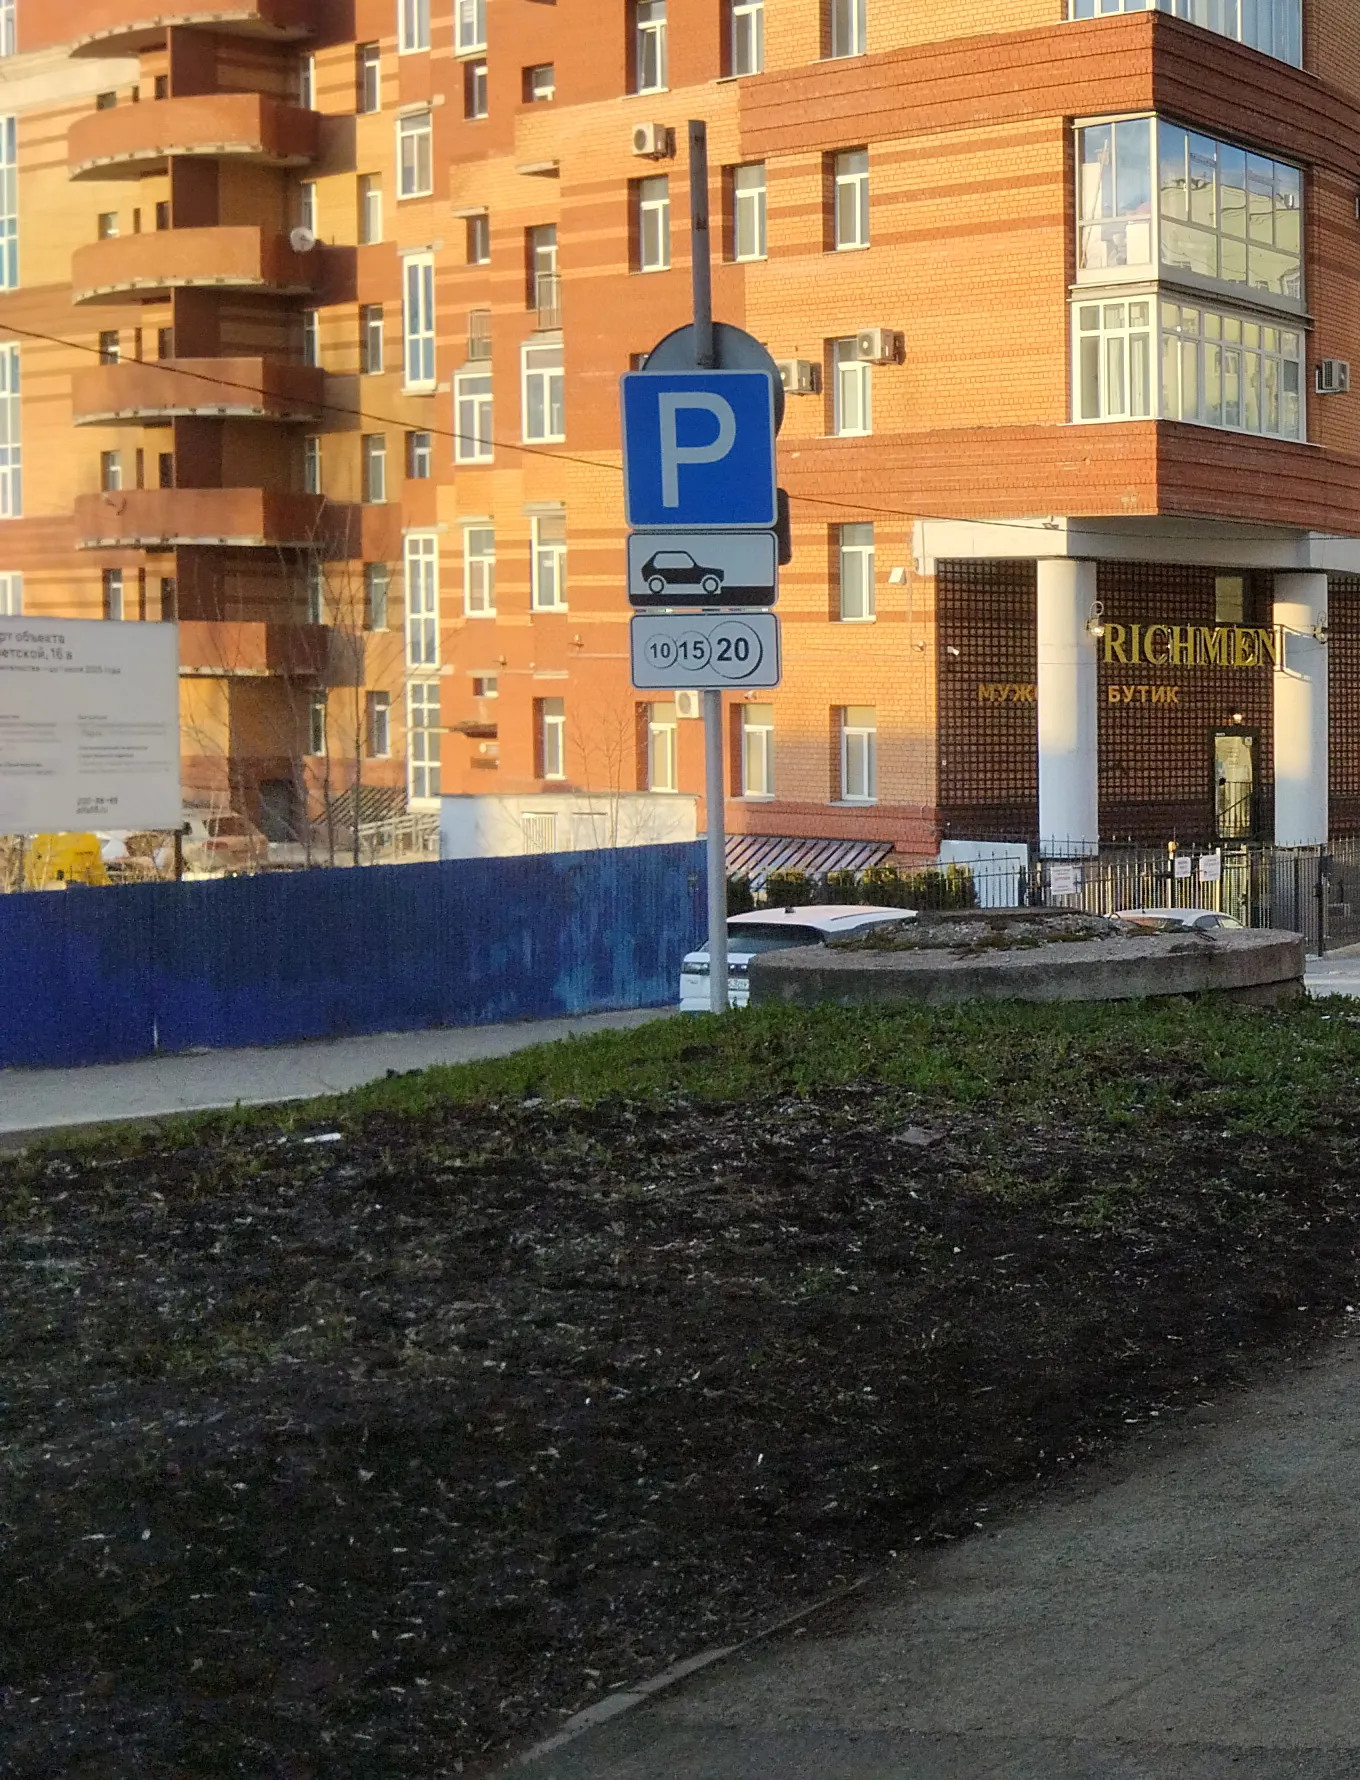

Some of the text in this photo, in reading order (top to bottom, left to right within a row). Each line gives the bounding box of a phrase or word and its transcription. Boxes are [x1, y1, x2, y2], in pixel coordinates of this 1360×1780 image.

[658, 391, 737, 508] P
[650, 637, 750, 662] 10 15 20
[1103, 622, 1277, 667] RICHMEN
[978, 684, 1180, 703] МУЖ БУТИК
